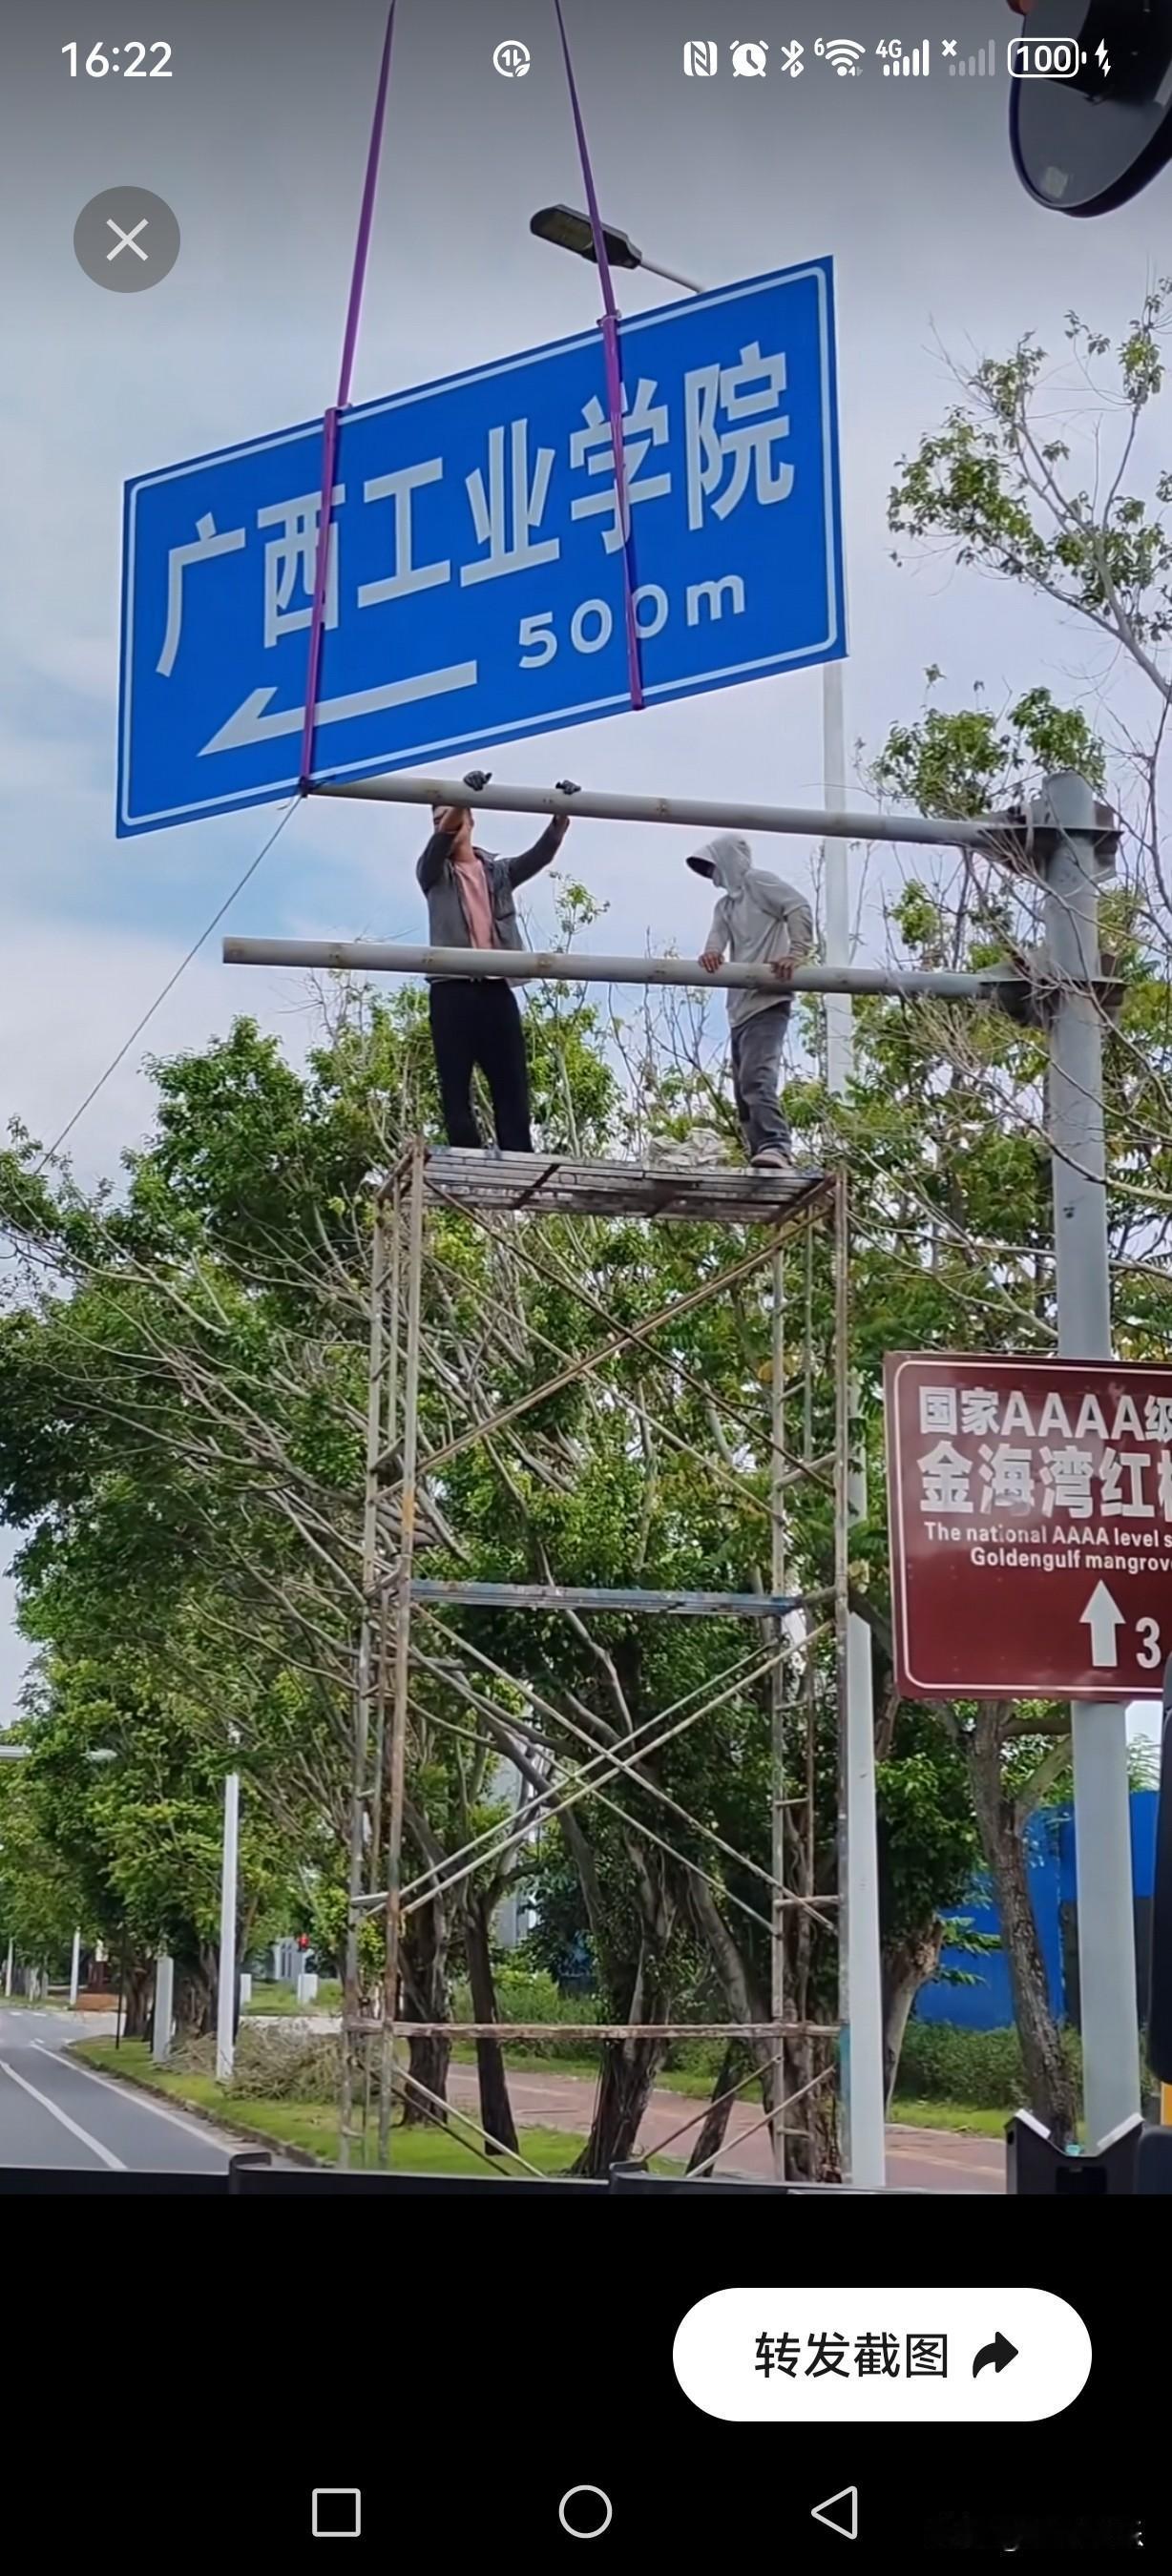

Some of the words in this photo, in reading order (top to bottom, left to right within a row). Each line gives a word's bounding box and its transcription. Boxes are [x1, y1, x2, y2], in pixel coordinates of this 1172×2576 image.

[156, 341, 795, 677] 广西工业学院
[518, 574, 745, 669] 500m
[916, 1440, 1172, 1524] 金海湾红
[924, 1521, 961, 1542] The
[967, 1524, 1047, 1545] national
[1052, 1526, 1109, 1546] AAAA
[1115, 1527, 1159, 1548] level
[970, 1547, 1080, 1571] Goldengulf
[1085, 1554, 1172, 1574] mangrov
[1135, 1616, 1162, 1669] 3
